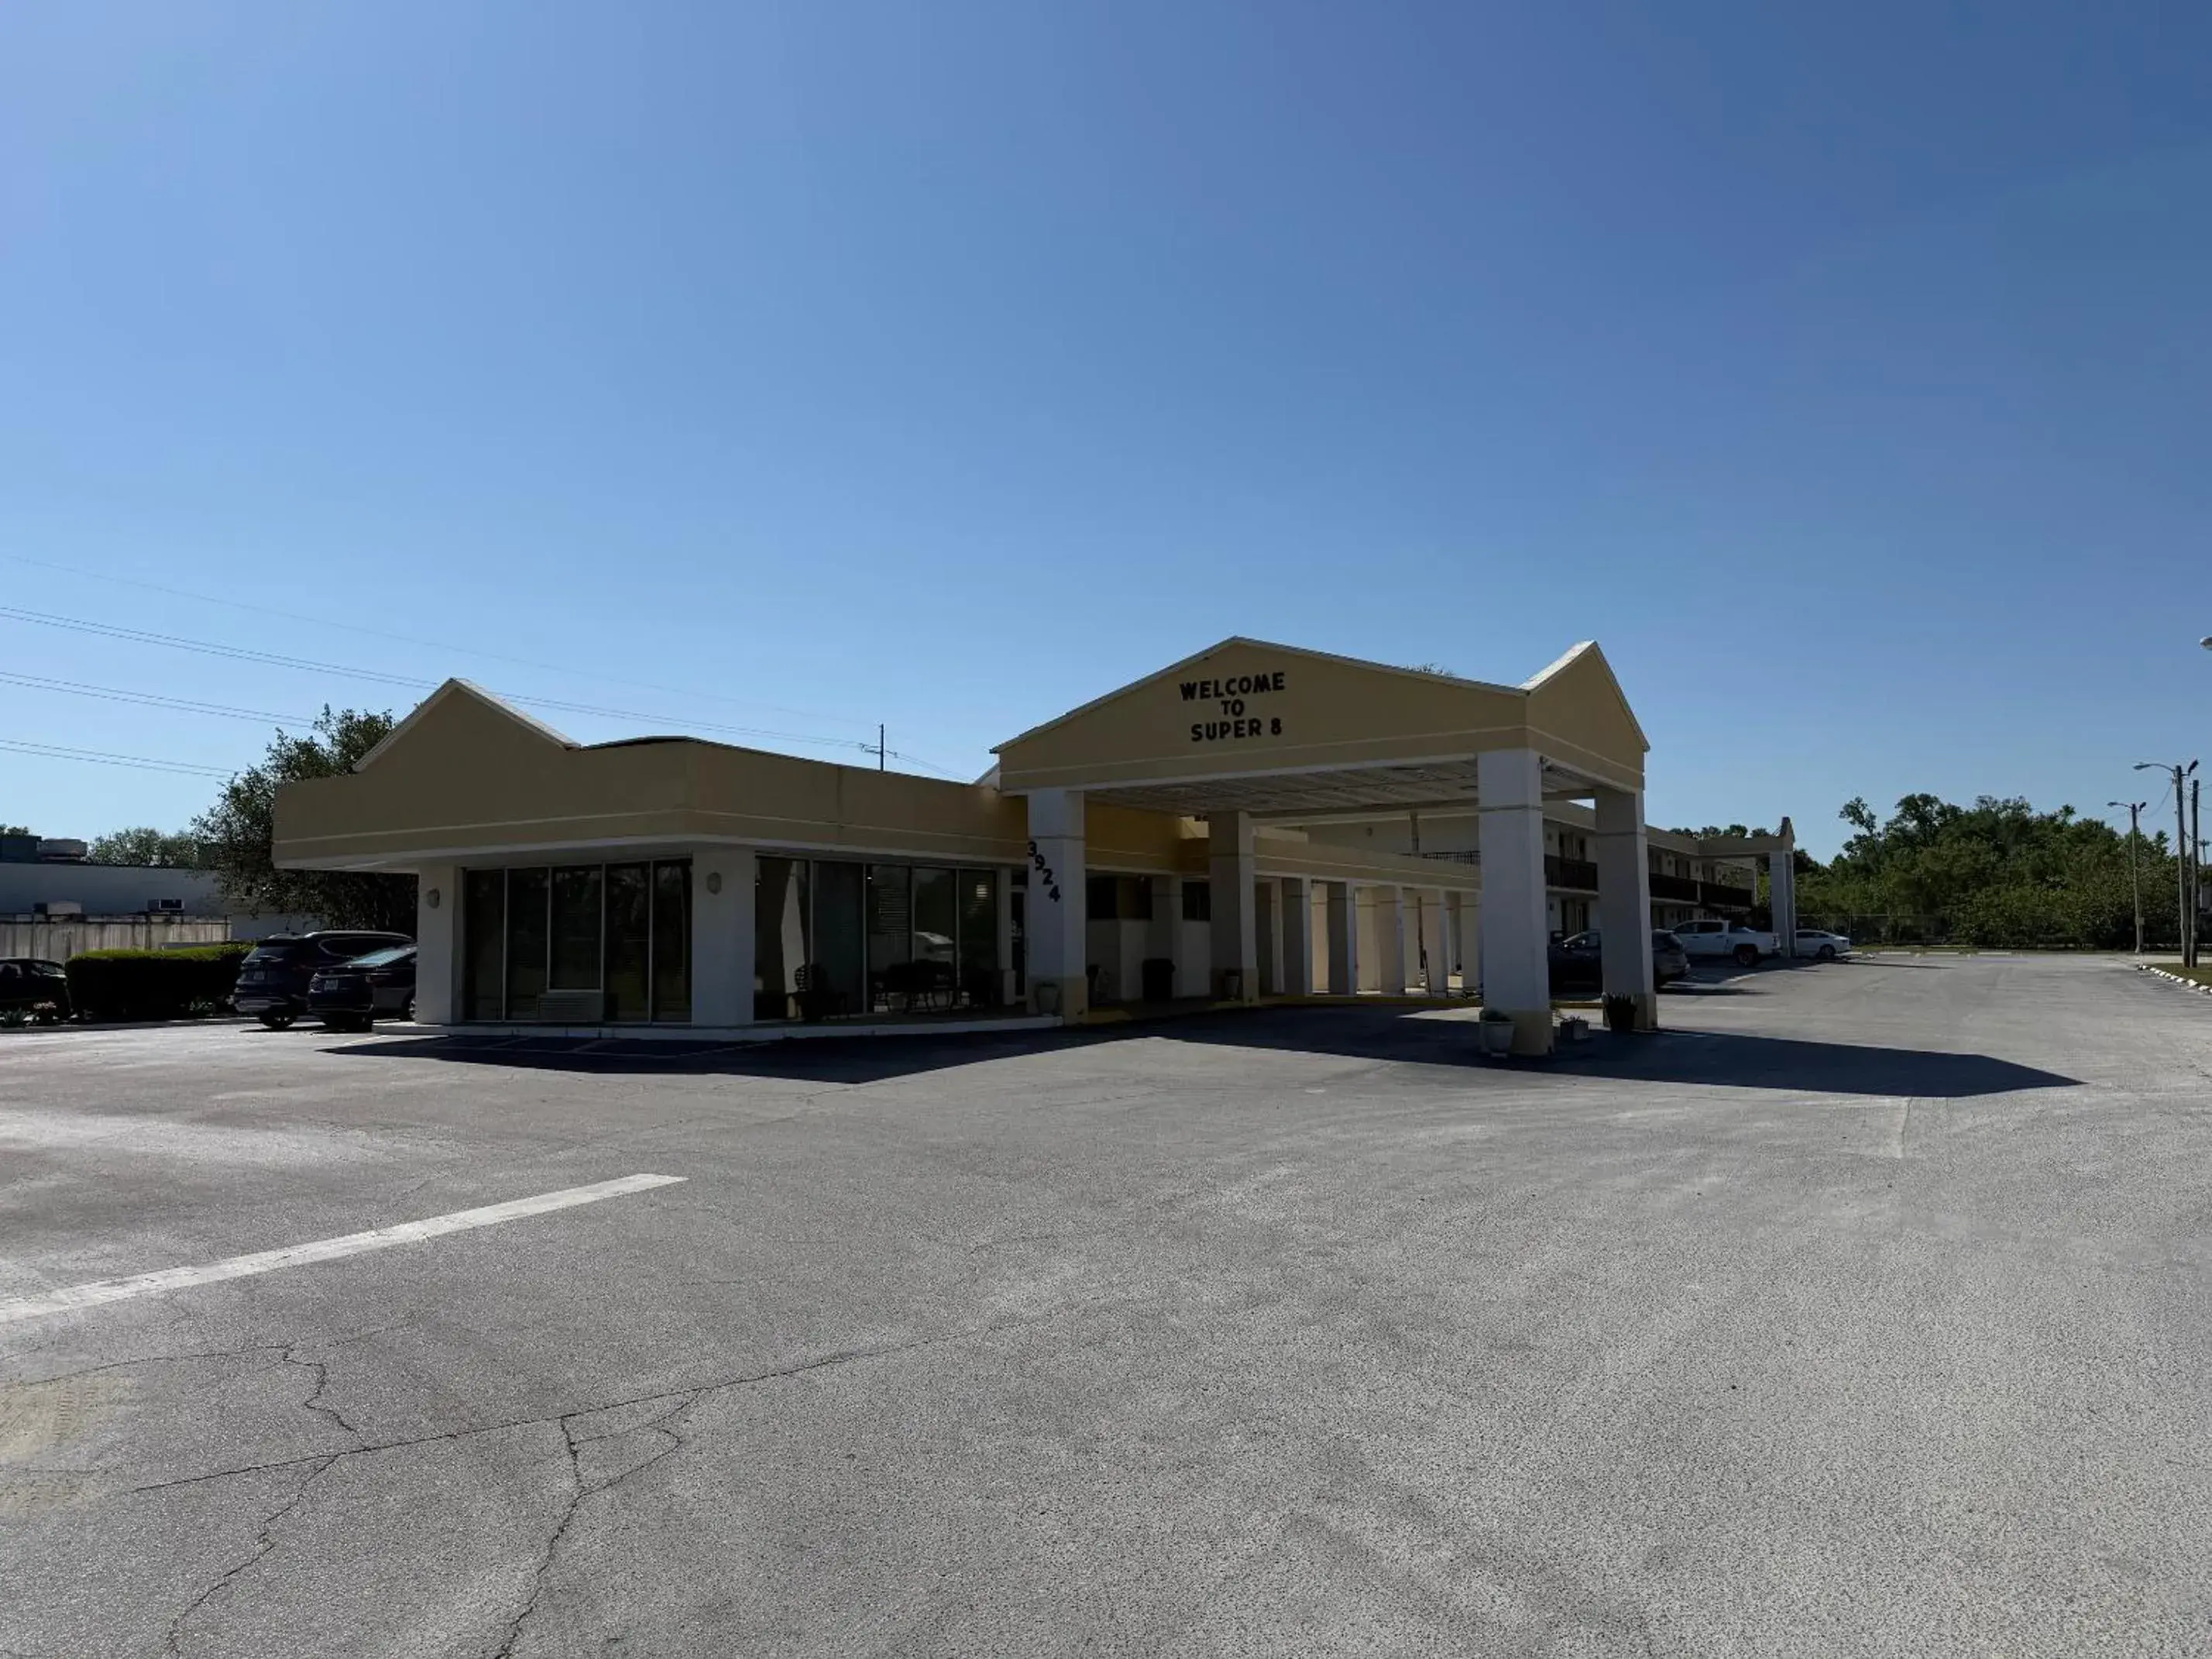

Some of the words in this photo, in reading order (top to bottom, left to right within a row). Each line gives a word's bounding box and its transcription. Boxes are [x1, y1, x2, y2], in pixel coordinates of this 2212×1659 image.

[1179, 672, 1286, 701] WELCOME
[1221, 699, 1245, 716] TO
[1190, 718, 1262, 742] SUPER
[1270, 717, 1283, 735] 8
[1027, 841, 1061, 902] 3924
